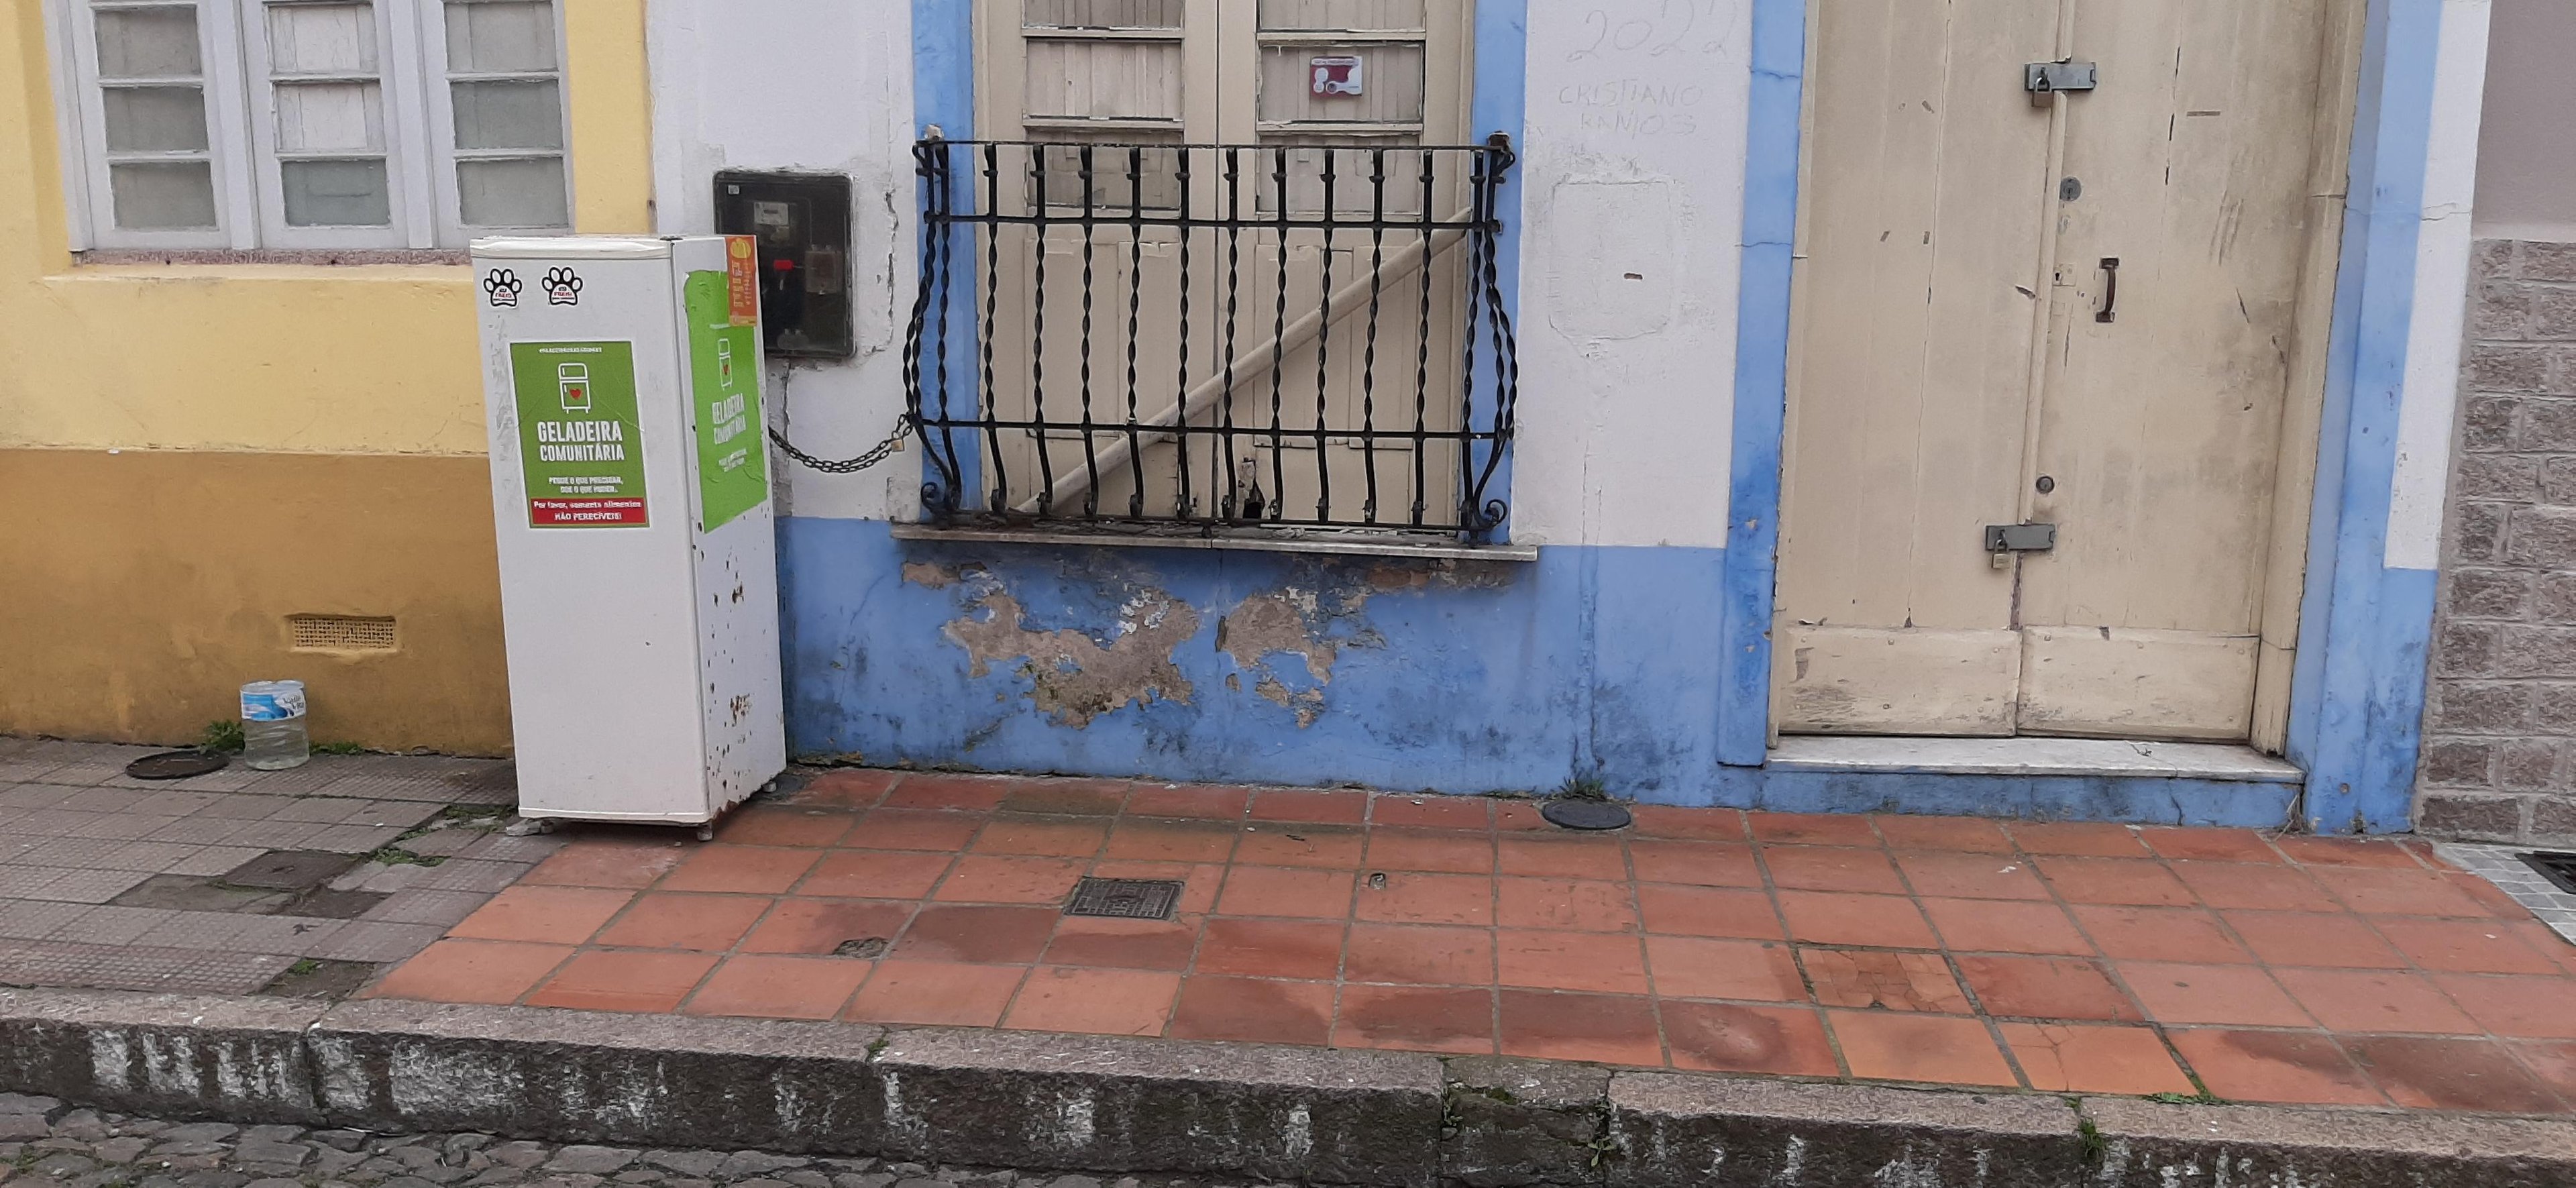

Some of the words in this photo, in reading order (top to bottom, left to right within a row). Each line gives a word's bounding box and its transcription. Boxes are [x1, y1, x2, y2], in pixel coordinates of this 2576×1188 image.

[537, 421, 623, 442] GELADEIRA
[539, 443, 625, 462] COMUNITÁRIA
[555, 512, 572, 521] NÃO
